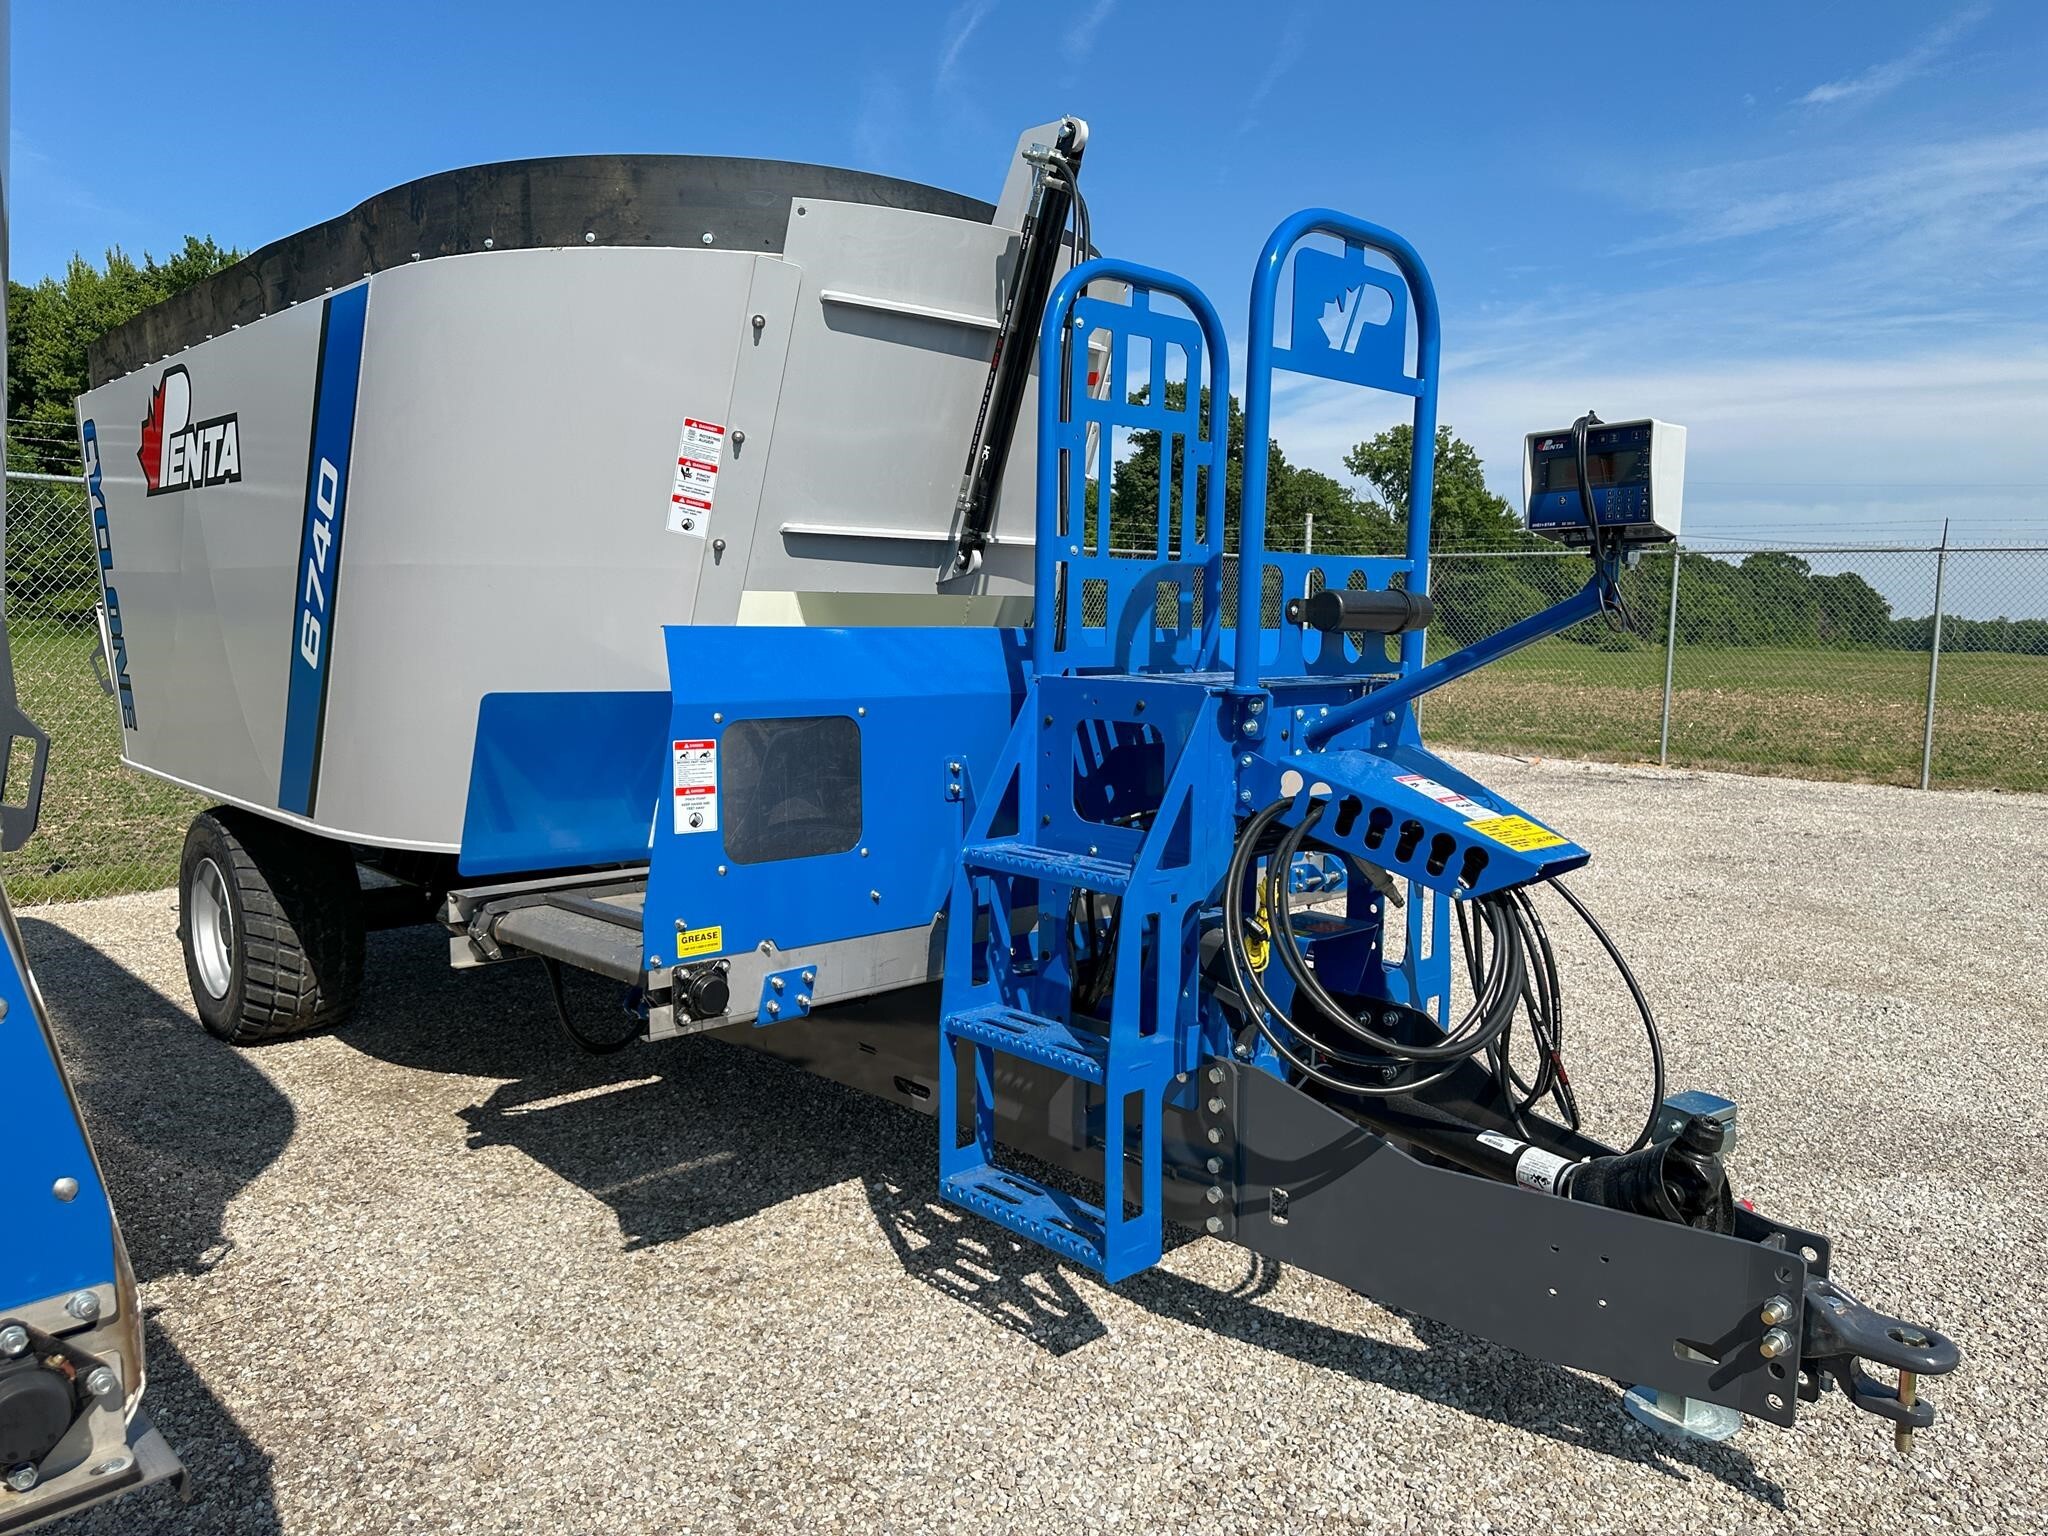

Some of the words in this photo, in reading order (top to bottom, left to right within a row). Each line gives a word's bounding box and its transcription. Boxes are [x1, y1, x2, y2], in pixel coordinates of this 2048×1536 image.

[159, 368, 240, 490] PENTA
[698, 423, 718, 432] DANGER
[699, 433, 720, 442] ROTATING
[692, 462, 711, 470] DANGER
[685, 498, 705, 508] DANGER
[301, 457, 338, 669] 6740
[83, 418, 138, 731] CYCLONE
[682, 932, 718, 944] GREASE
